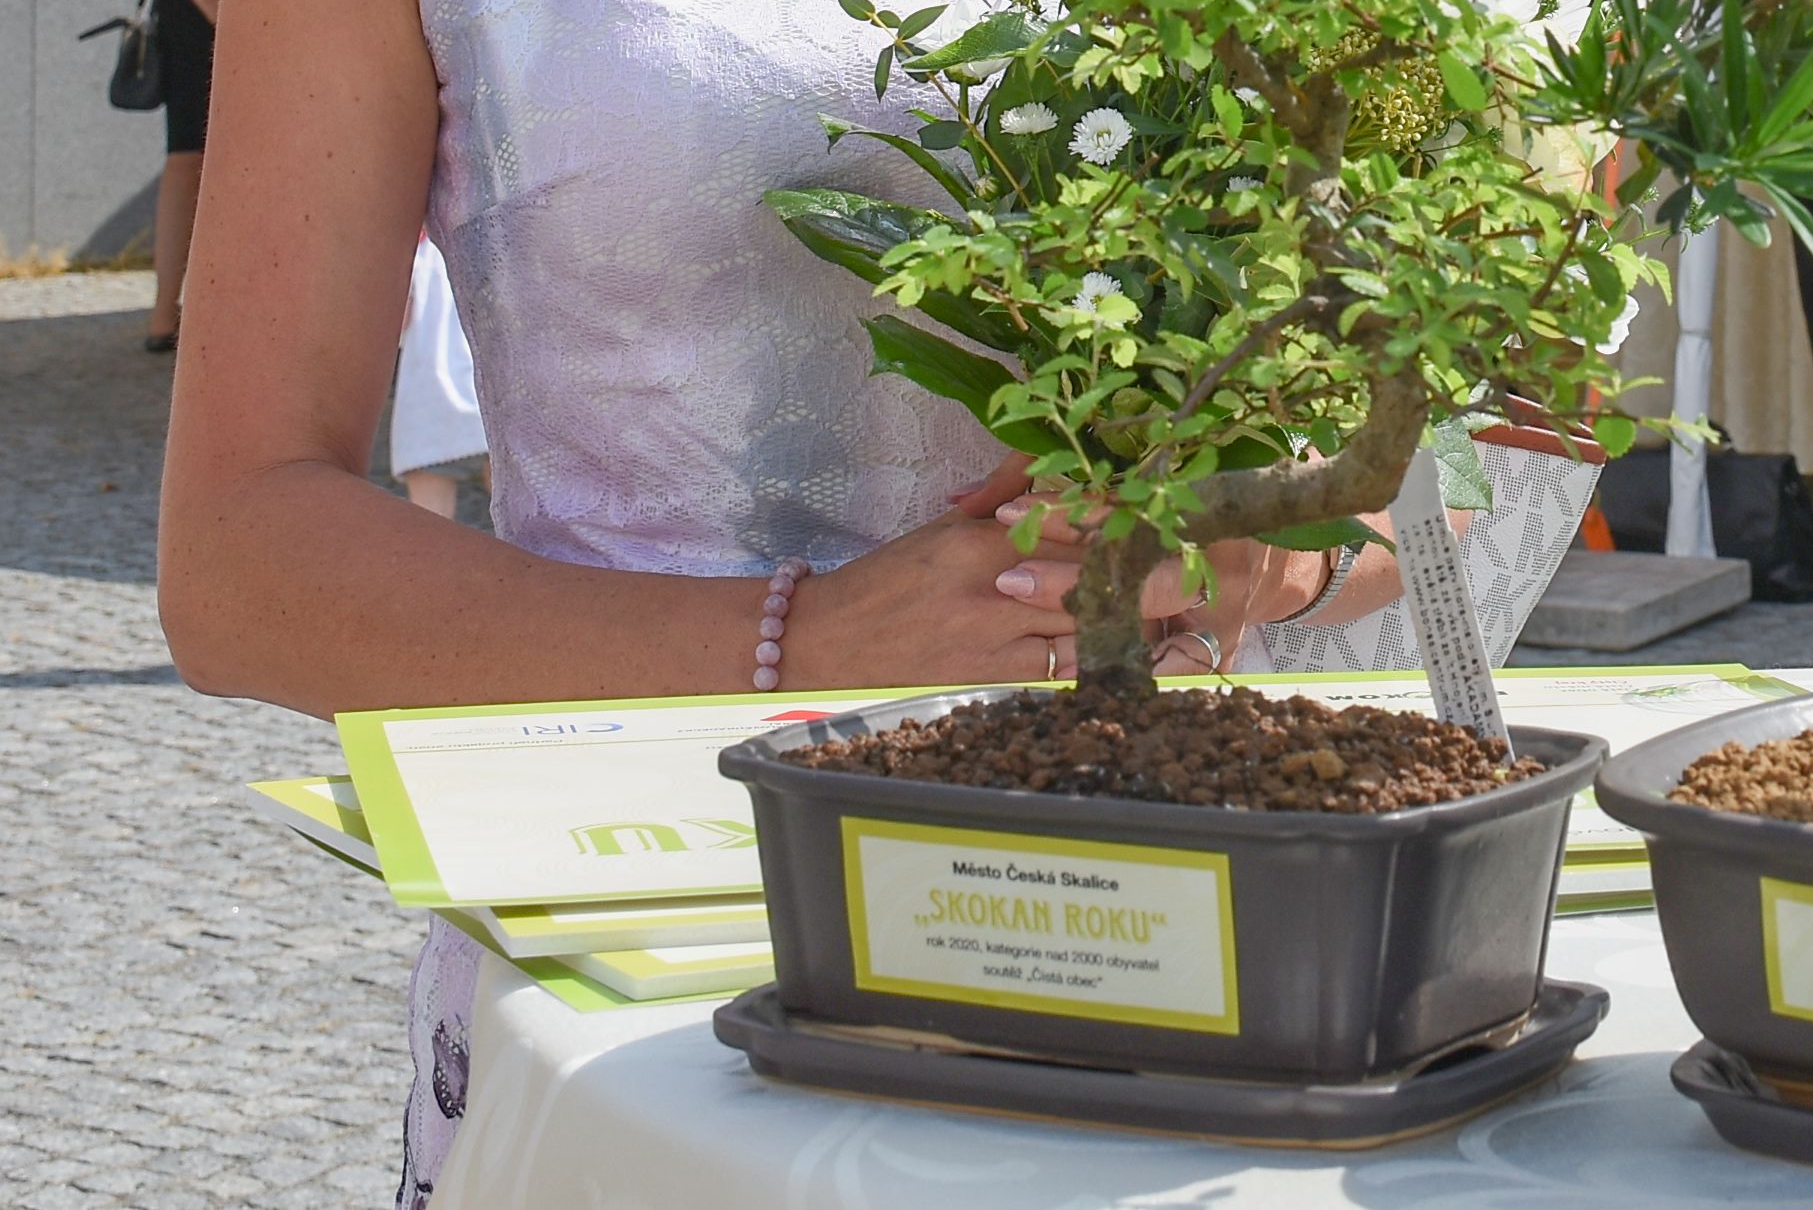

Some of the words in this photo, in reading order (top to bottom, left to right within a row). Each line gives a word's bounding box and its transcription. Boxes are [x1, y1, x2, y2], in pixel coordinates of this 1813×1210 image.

[522, 722, 624, 736] CIRI
[952, 861, 1001, 880] Město
[1006, 863, 1056, 886] Česká
[1061, 872, 1119, 892] Skalice
[926, 936, 945, 948] rok
[949, 937, 983, 954] 2020,
[986, 941, 1042, 960] kategorie
[1046, 948, 1068, 962] nad
[1072, 951, 1103, 966] 2000
[1106, 954, 1160, 972] obyvatel
[983, 963, 1022, 979] soutěž
